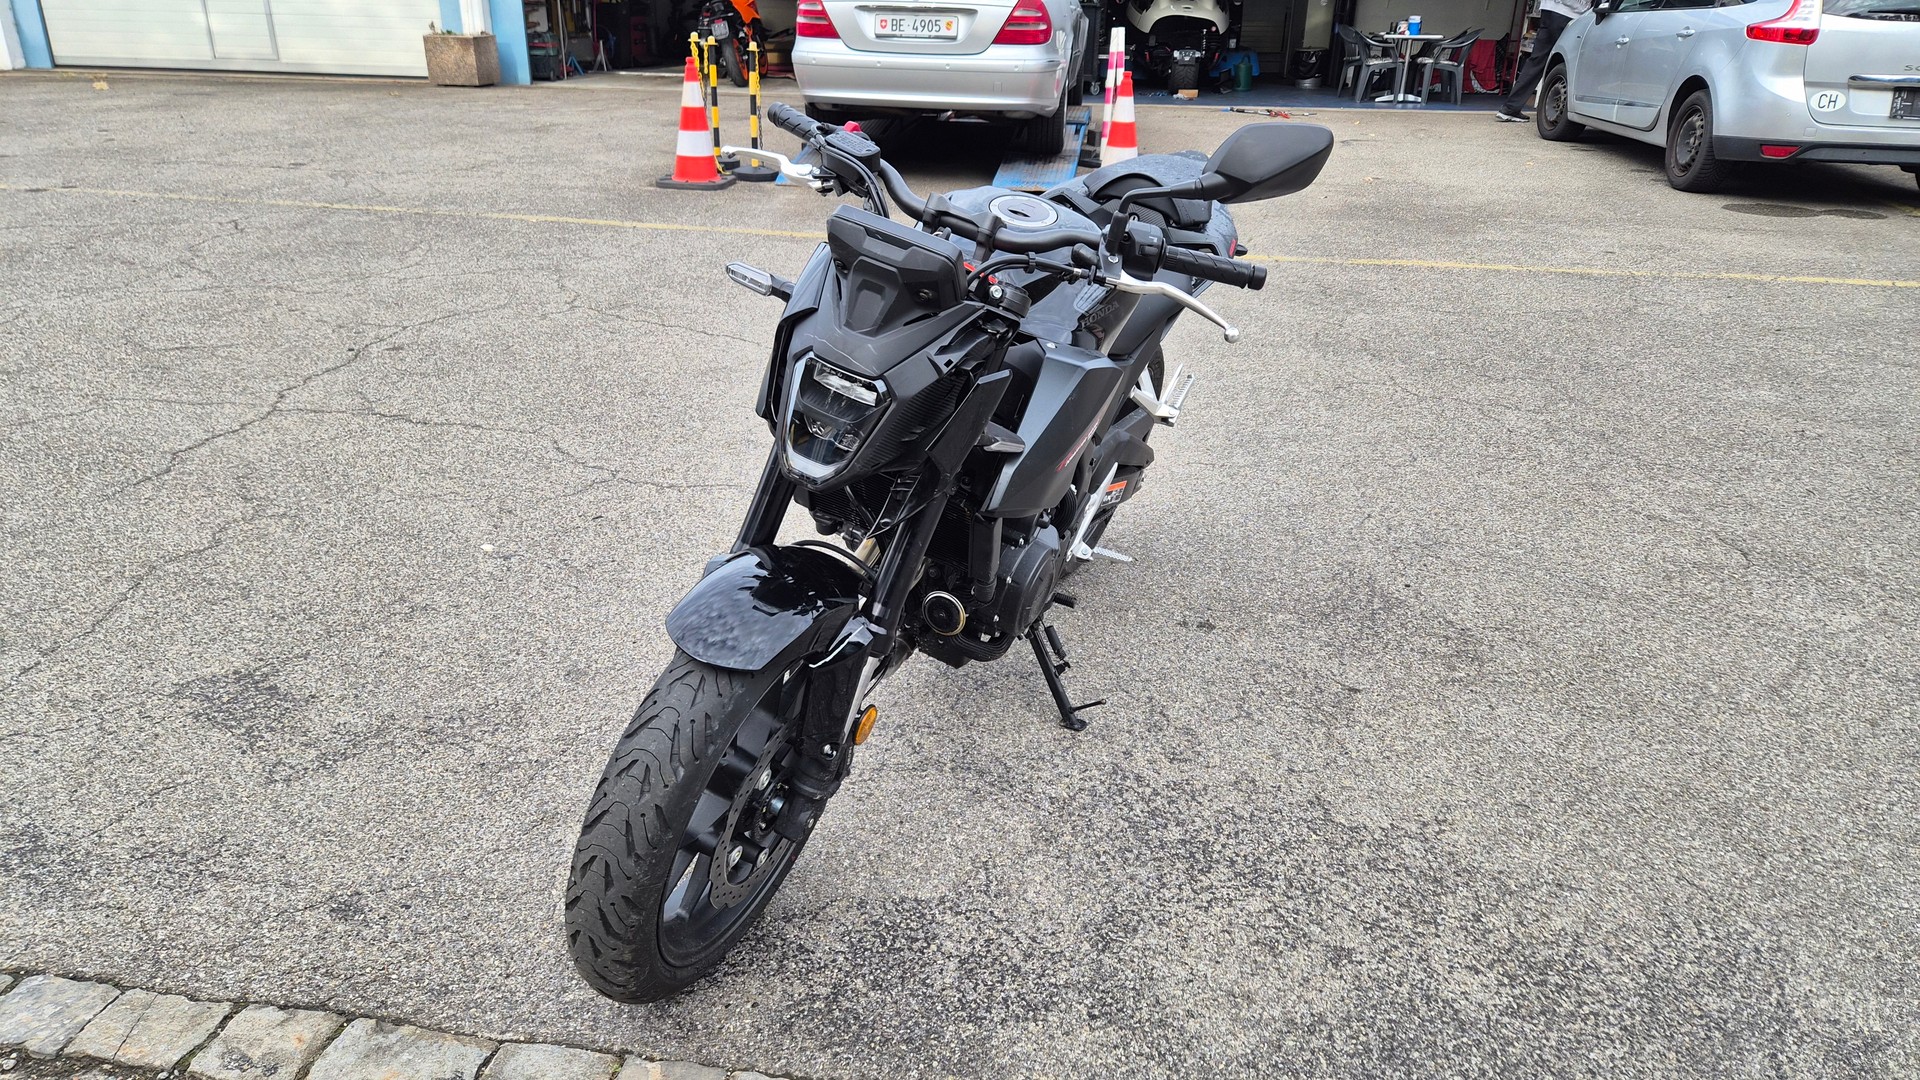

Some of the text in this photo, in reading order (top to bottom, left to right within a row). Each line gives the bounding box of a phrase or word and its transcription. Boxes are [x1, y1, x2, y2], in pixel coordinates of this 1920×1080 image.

[891, 18, 941, 32] BE 4905
[1817, 93, 1838, 109] CH
[1080, 301, 1119, 328] HONDA
